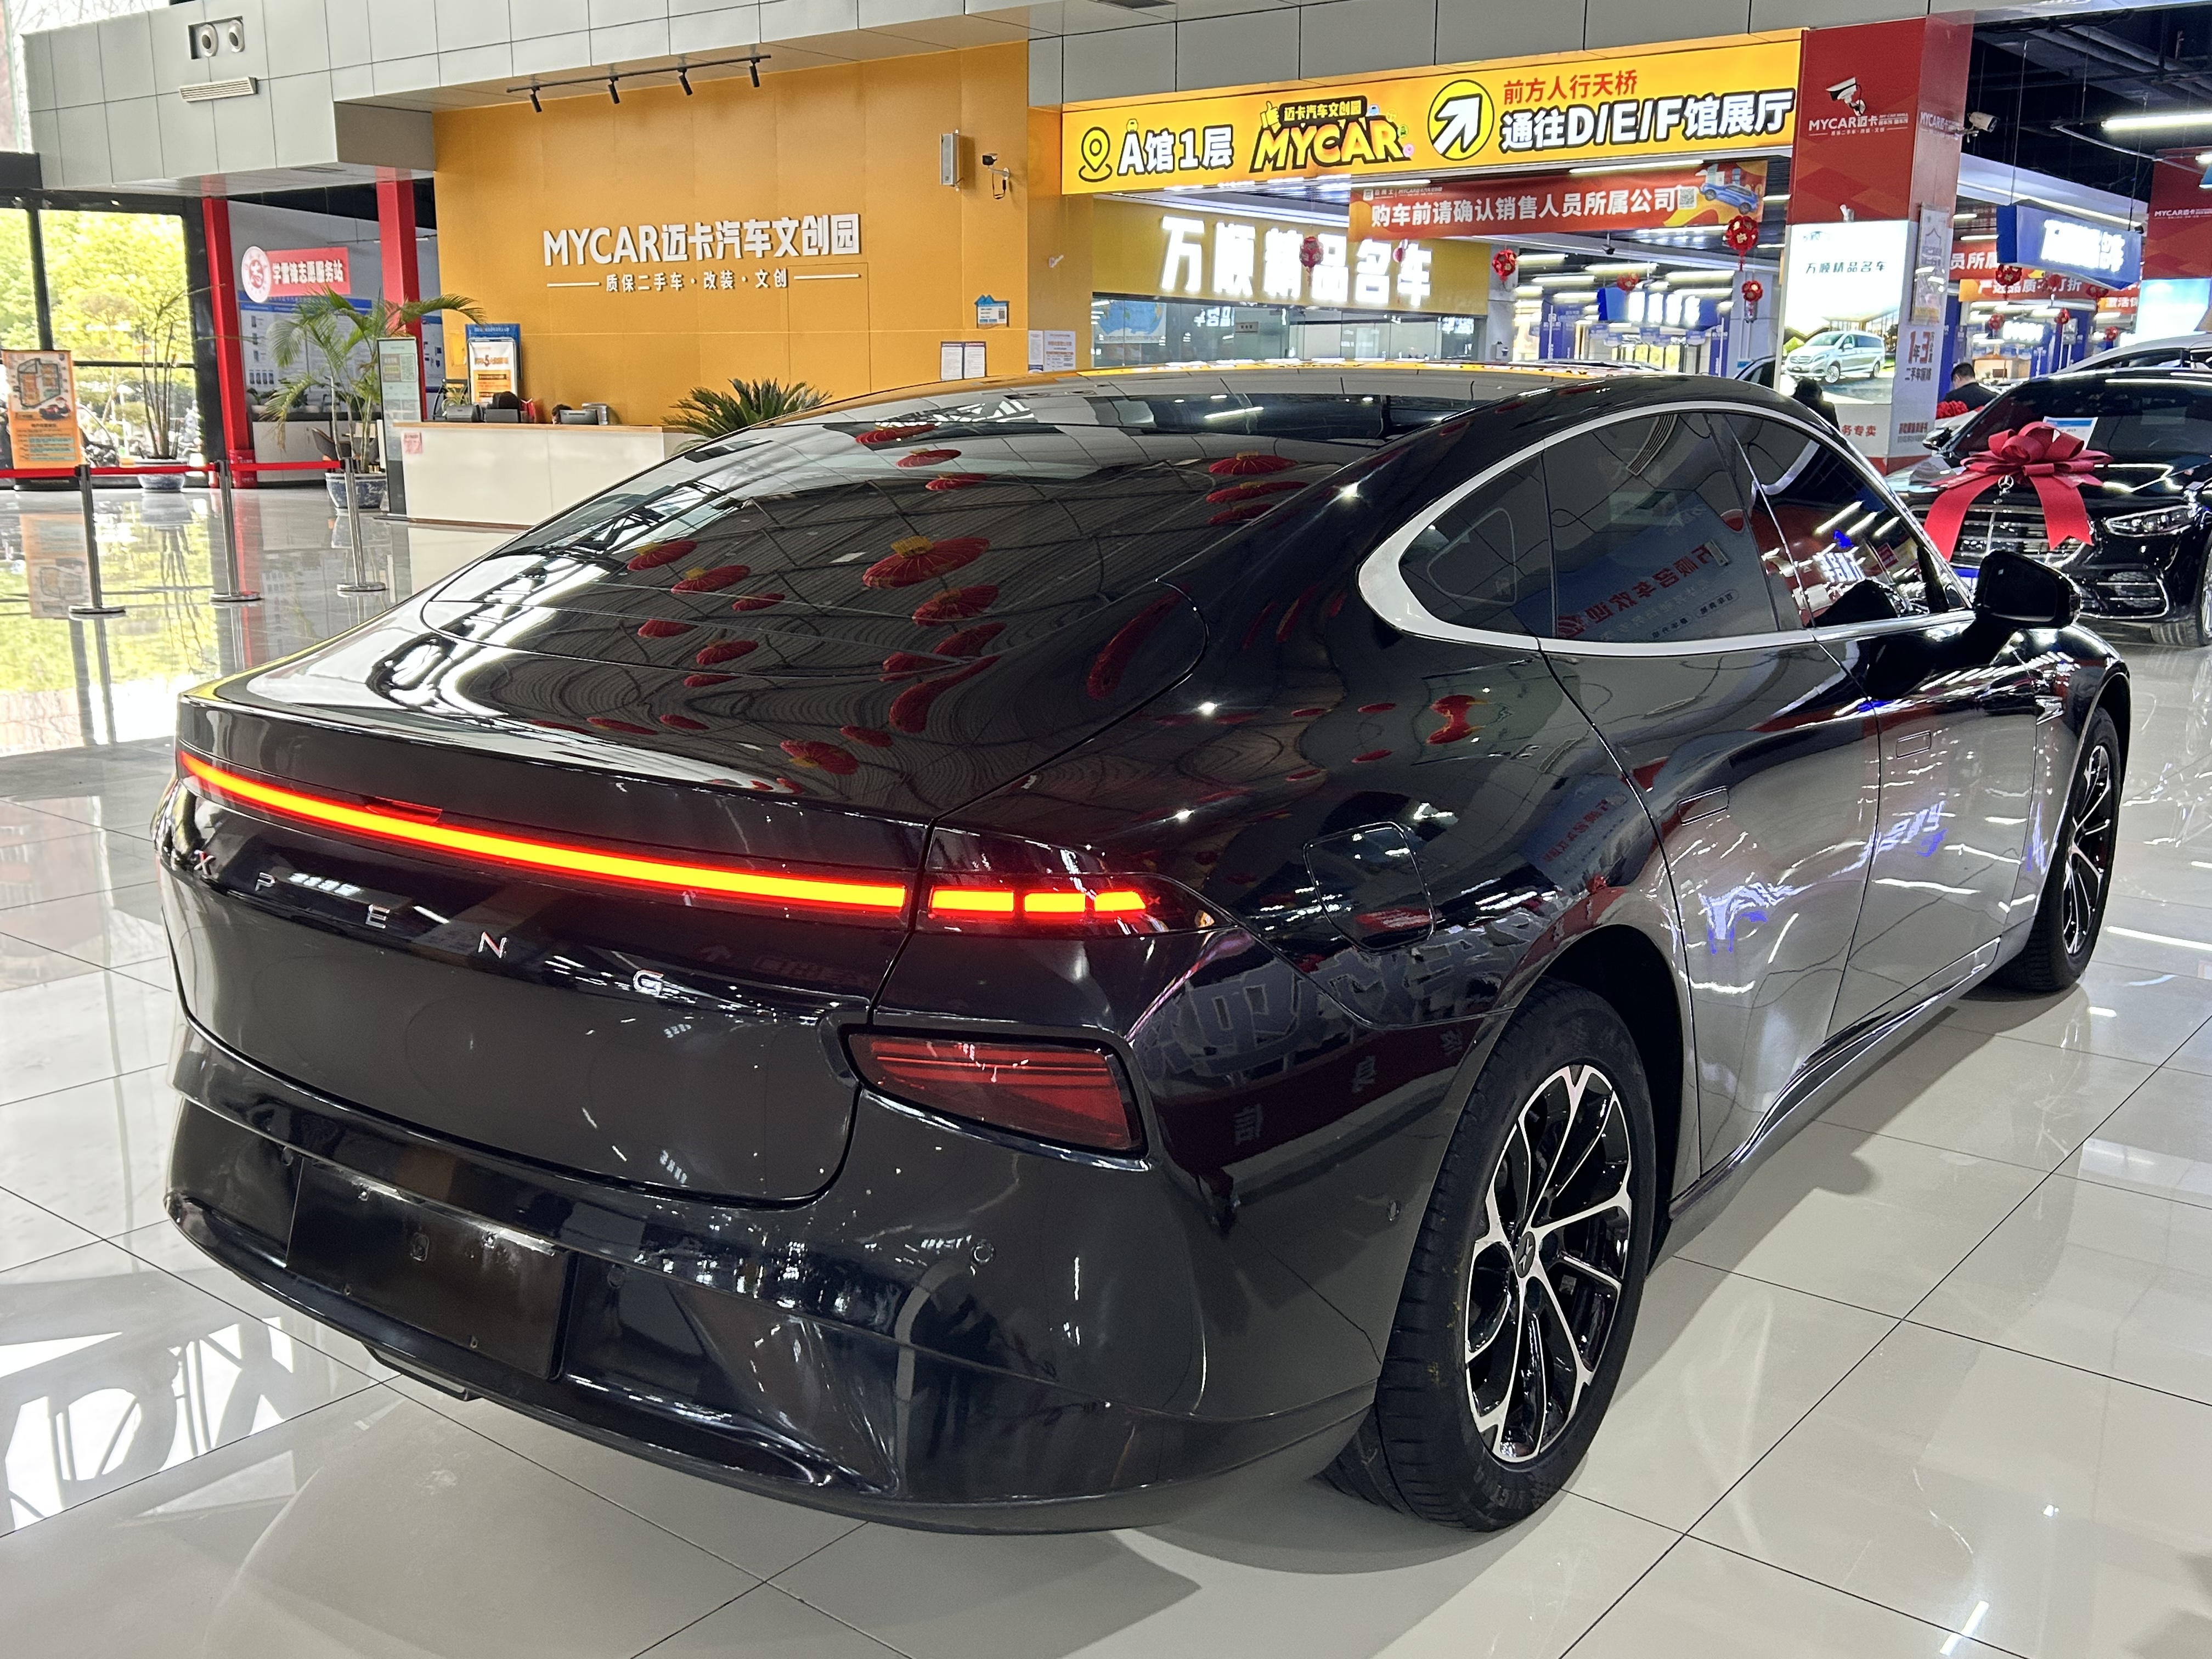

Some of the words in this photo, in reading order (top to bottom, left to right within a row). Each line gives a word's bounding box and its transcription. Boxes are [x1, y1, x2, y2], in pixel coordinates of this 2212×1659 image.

[1284, 100, 1362, 121] 迈卡汽车文创园
[1504, 70, 1638, 105] 前方人行天桥
[1251, 119, 1407, 171] MYCAR
[1500, 90, 1795, 153] 通往D/E/F馆展厅
[1118, 126, 1233, 175] A馆1层
[1372, 188, 1677, 228] 购车前请确认销售人员所属公司
[543, 213, 861, 266] MYCAR迈卡汽车文创园
[272, 259, 344, 284] 学雷锋志愿服务站
[194, 850, 664, 997] XPENG
